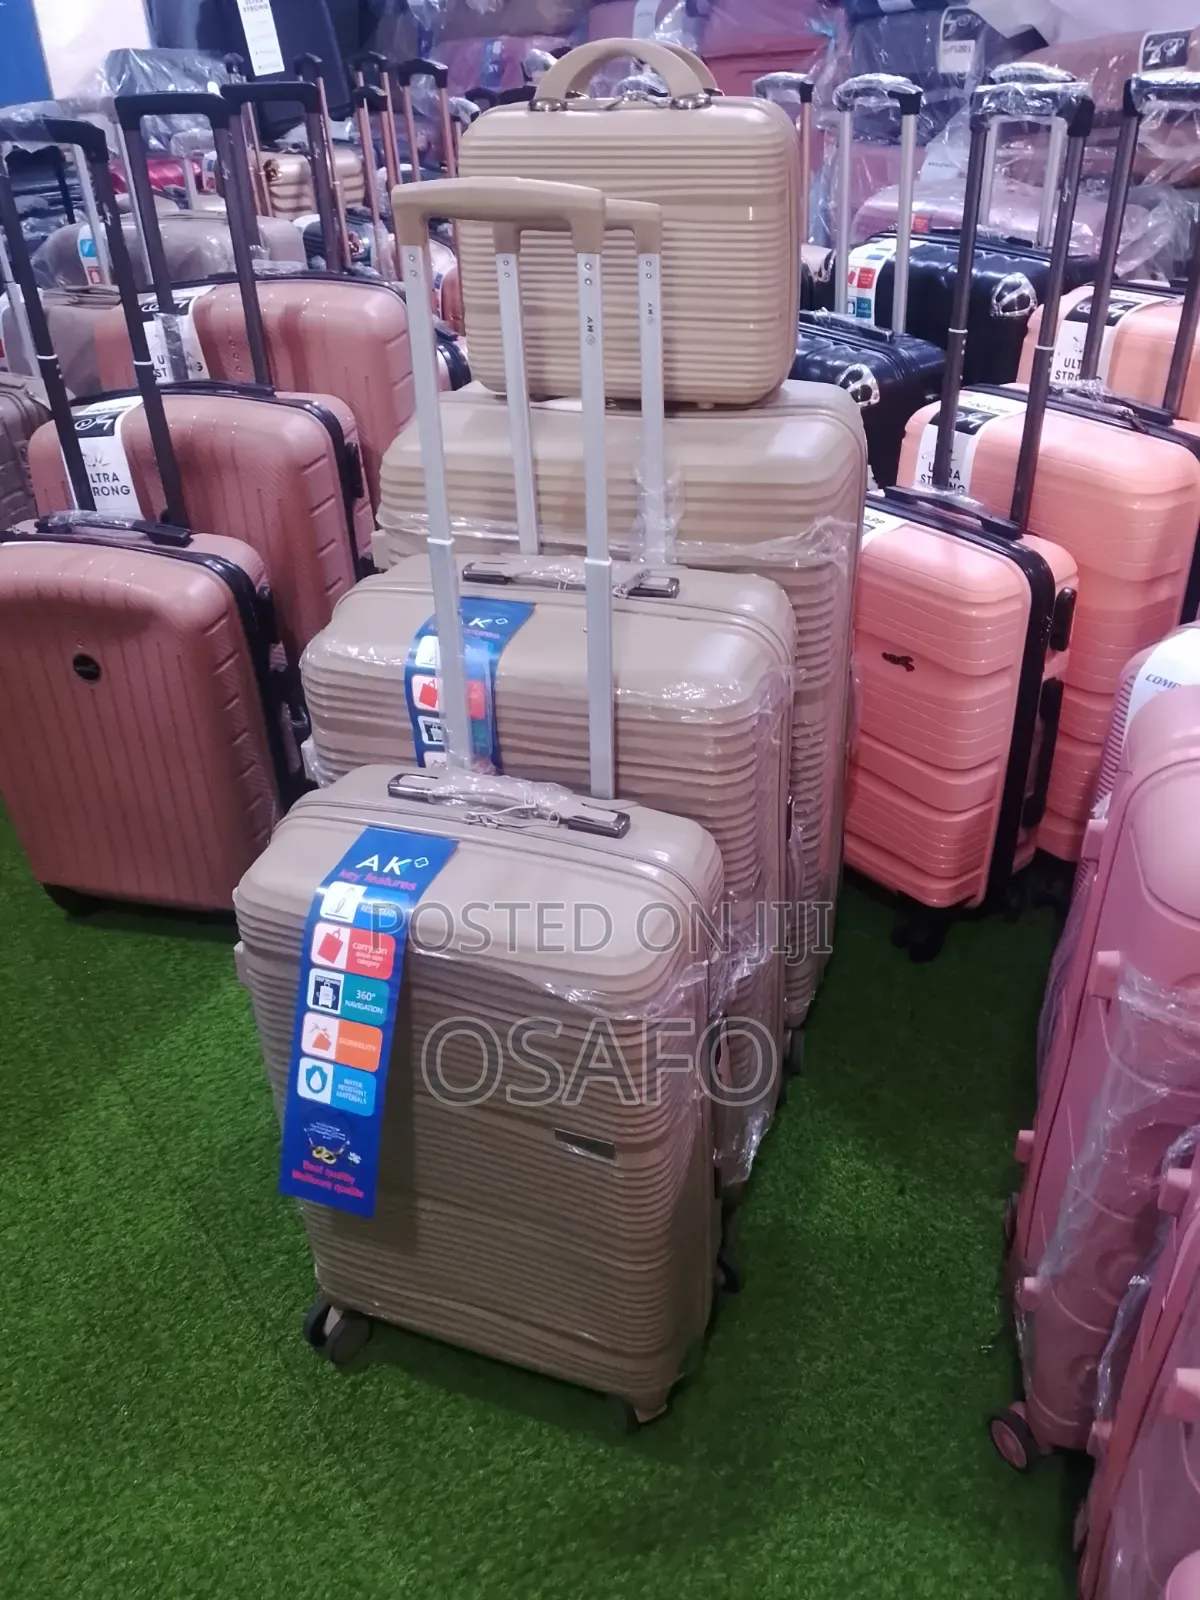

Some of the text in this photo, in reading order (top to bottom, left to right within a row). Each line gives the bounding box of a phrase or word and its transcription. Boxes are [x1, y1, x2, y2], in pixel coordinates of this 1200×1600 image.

[90, 472, 120, 484] LTRA
[92, 485, 131, 497] RONG
[355, 854, 412, 875] AK
[364, 872, 417, 891] features
[344, 999, 384, 1015] NAVIGATION
